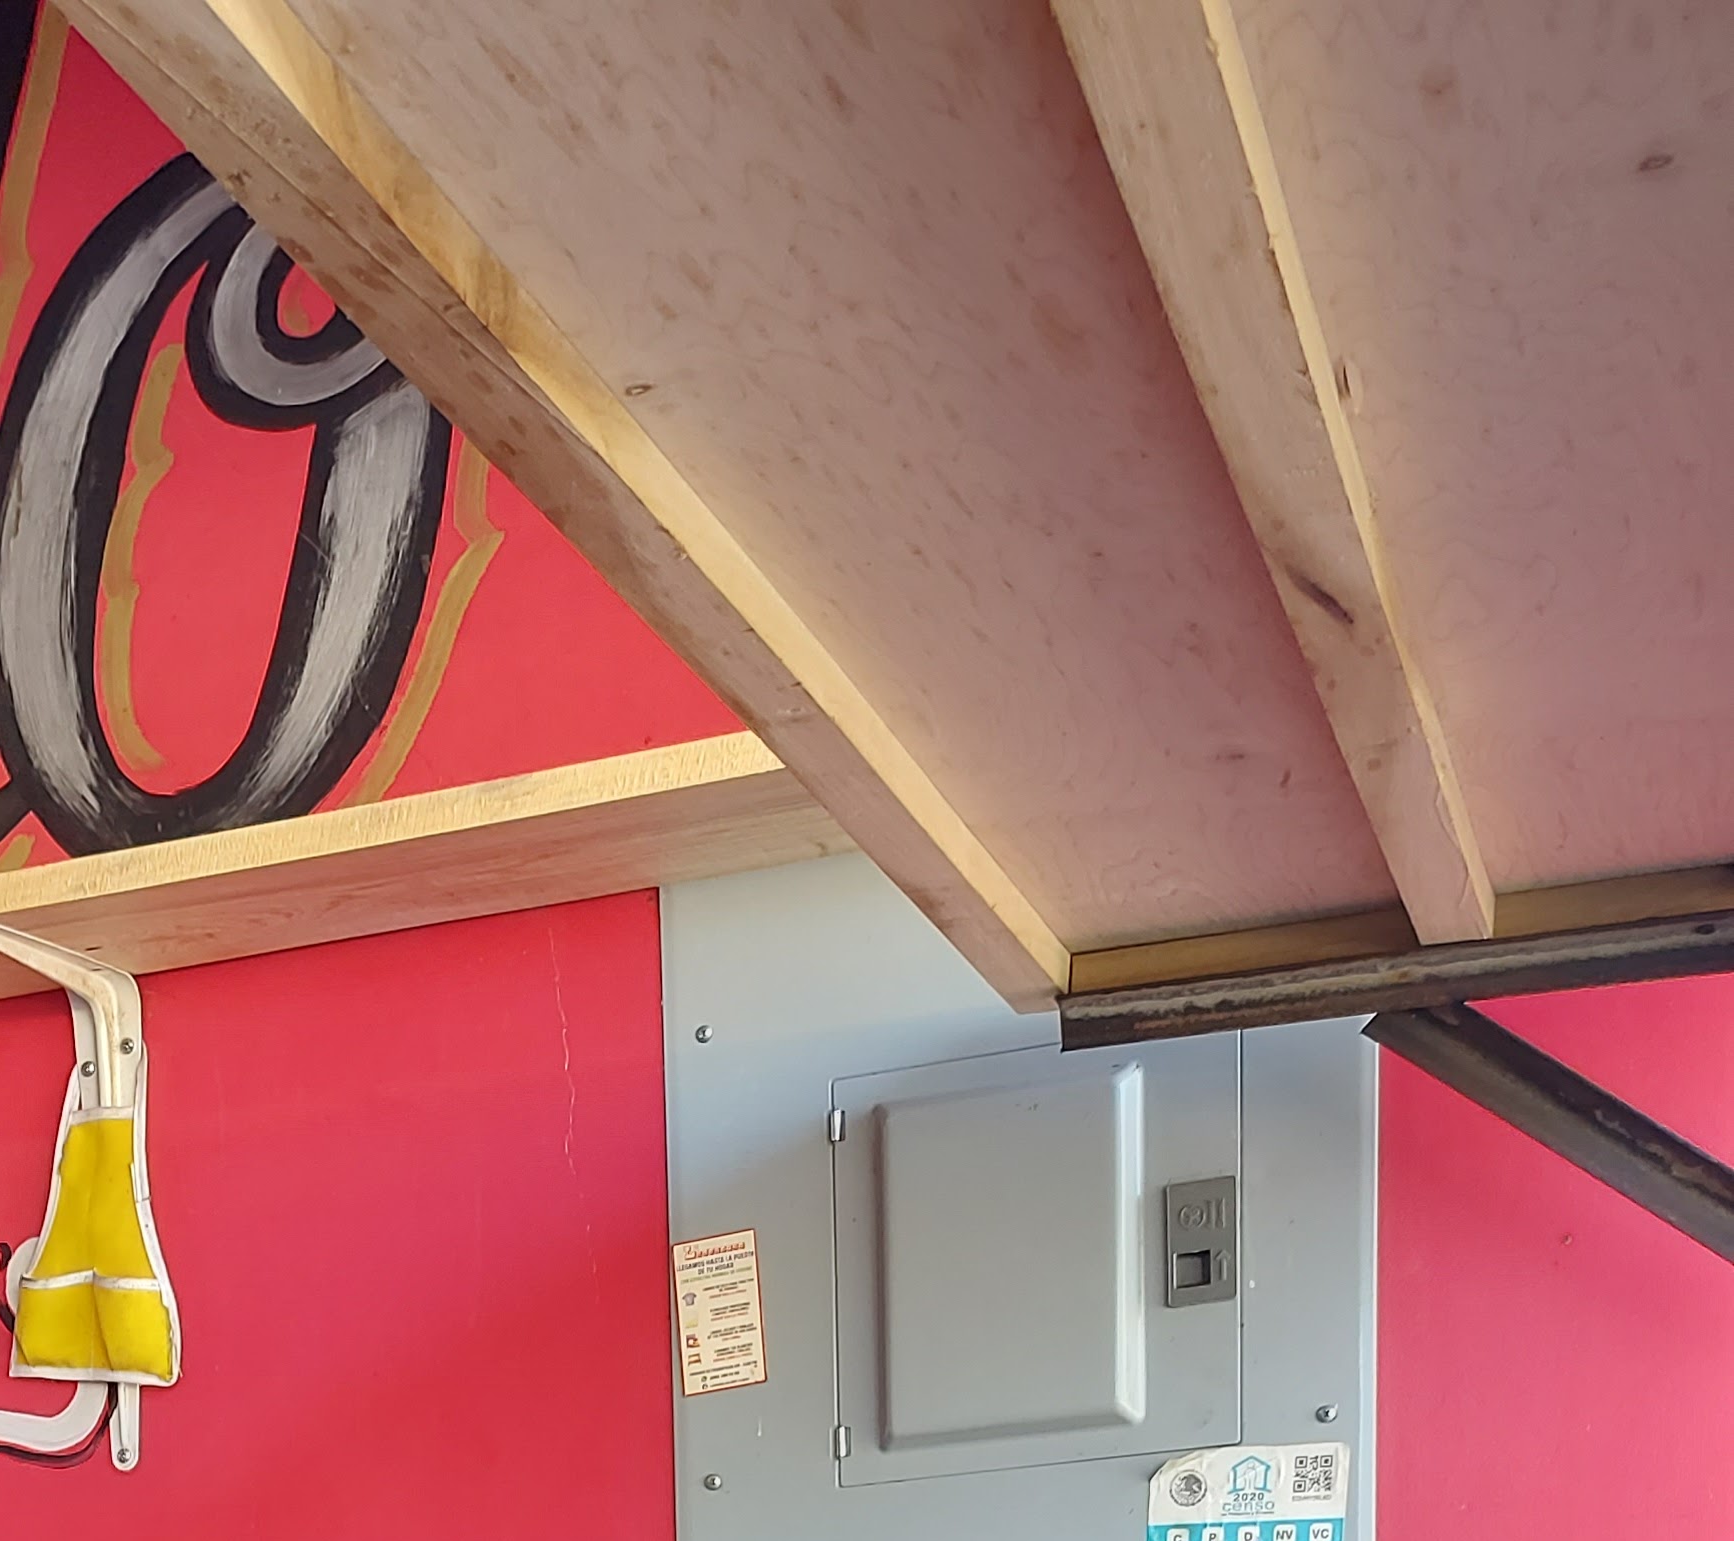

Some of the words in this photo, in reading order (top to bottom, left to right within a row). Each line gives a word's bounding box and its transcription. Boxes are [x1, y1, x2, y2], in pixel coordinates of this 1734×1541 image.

[1233, 1492, 1264, 1502] 2020
[1222, 1500, 1275, 1512] censo
[1244, 1531, 1253, 1541] D
[1276, 1530, 1294, 1541] NV
[1312, 1528, 1330, 1539] VC
